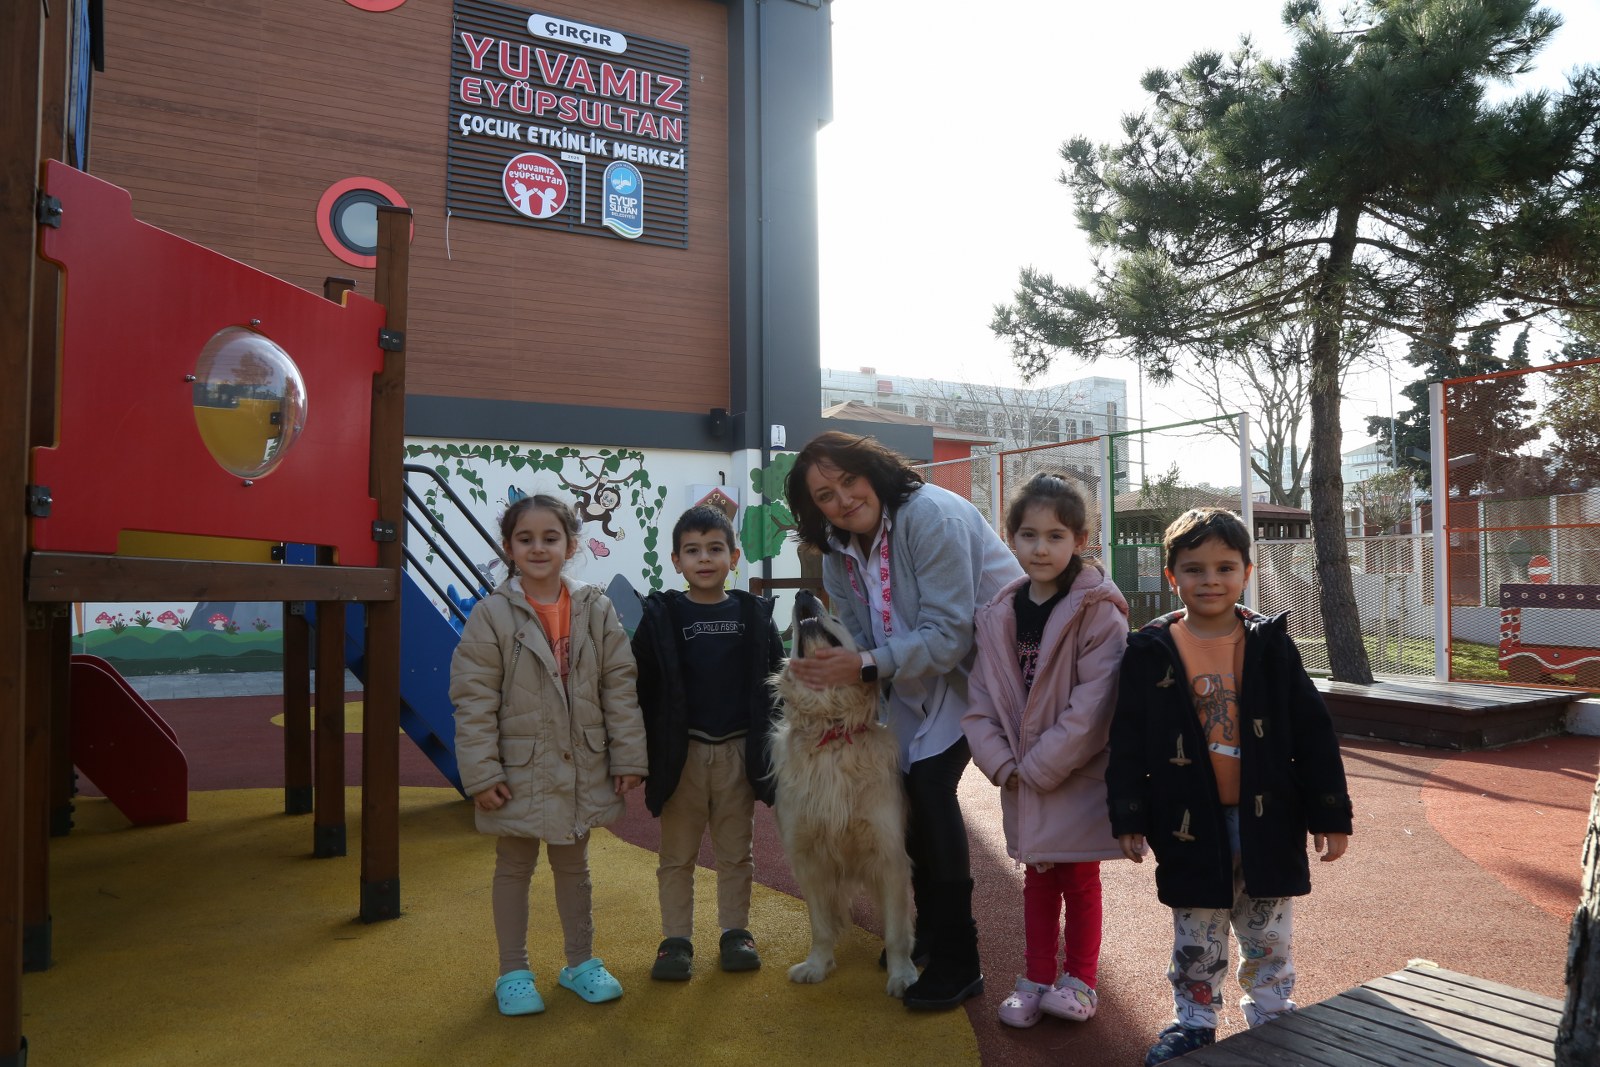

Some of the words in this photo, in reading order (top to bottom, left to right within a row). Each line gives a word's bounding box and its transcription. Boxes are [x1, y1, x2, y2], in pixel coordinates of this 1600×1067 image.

[544, 21, 612, 47] ÇIRÇIR
[461, 31, 684, 111] YUVAMIZ
[460, 76, 683, 143] EYÜPSULTAN
[459, 113, 522, 141] ÇOCUK
[527, 126, 608, 156] ETKİNLİK
[613, 141, 685, 170] MERKEZİ
[609, 194, 638, 208] EYÜP
[609, 203, 638, 216] SULTAN
